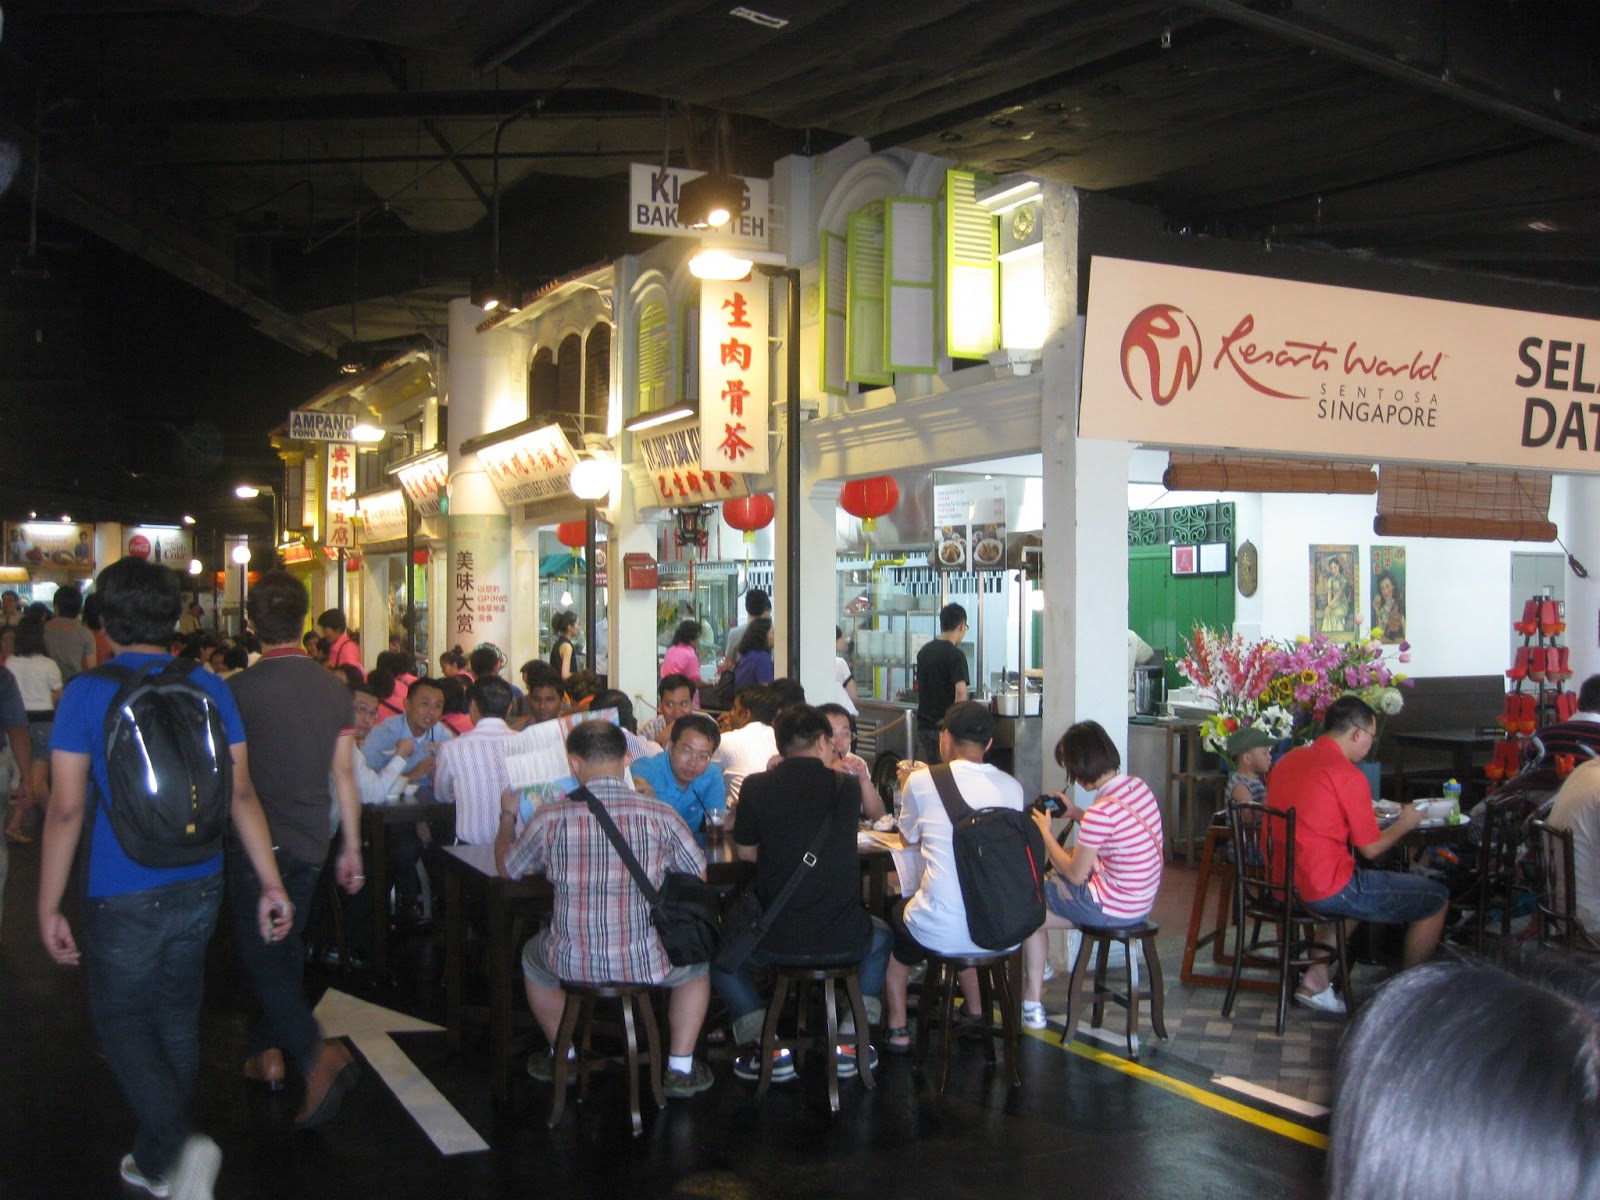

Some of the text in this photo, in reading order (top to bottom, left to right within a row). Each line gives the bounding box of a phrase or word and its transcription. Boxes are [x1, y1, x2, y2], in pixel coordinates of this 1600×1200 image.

[636, 203, 679, 228] BAK
[717, 272, 754, 463] 生肉骨茶
[1213, 313, 1443, 399] Resorts World
[1515, 336, 1600, 394] SEL
[1320, 383, 1438, 405] SENTOSA
[293, 414, 354, 430] AMPANG
[1317, 399, 1437, 428] SINGAPORE
[293, 429, 352, 439] YONG TAU FO
[641, 433, 675, 471] KLANG
[456, 551, 474, 634] 美味大赏
